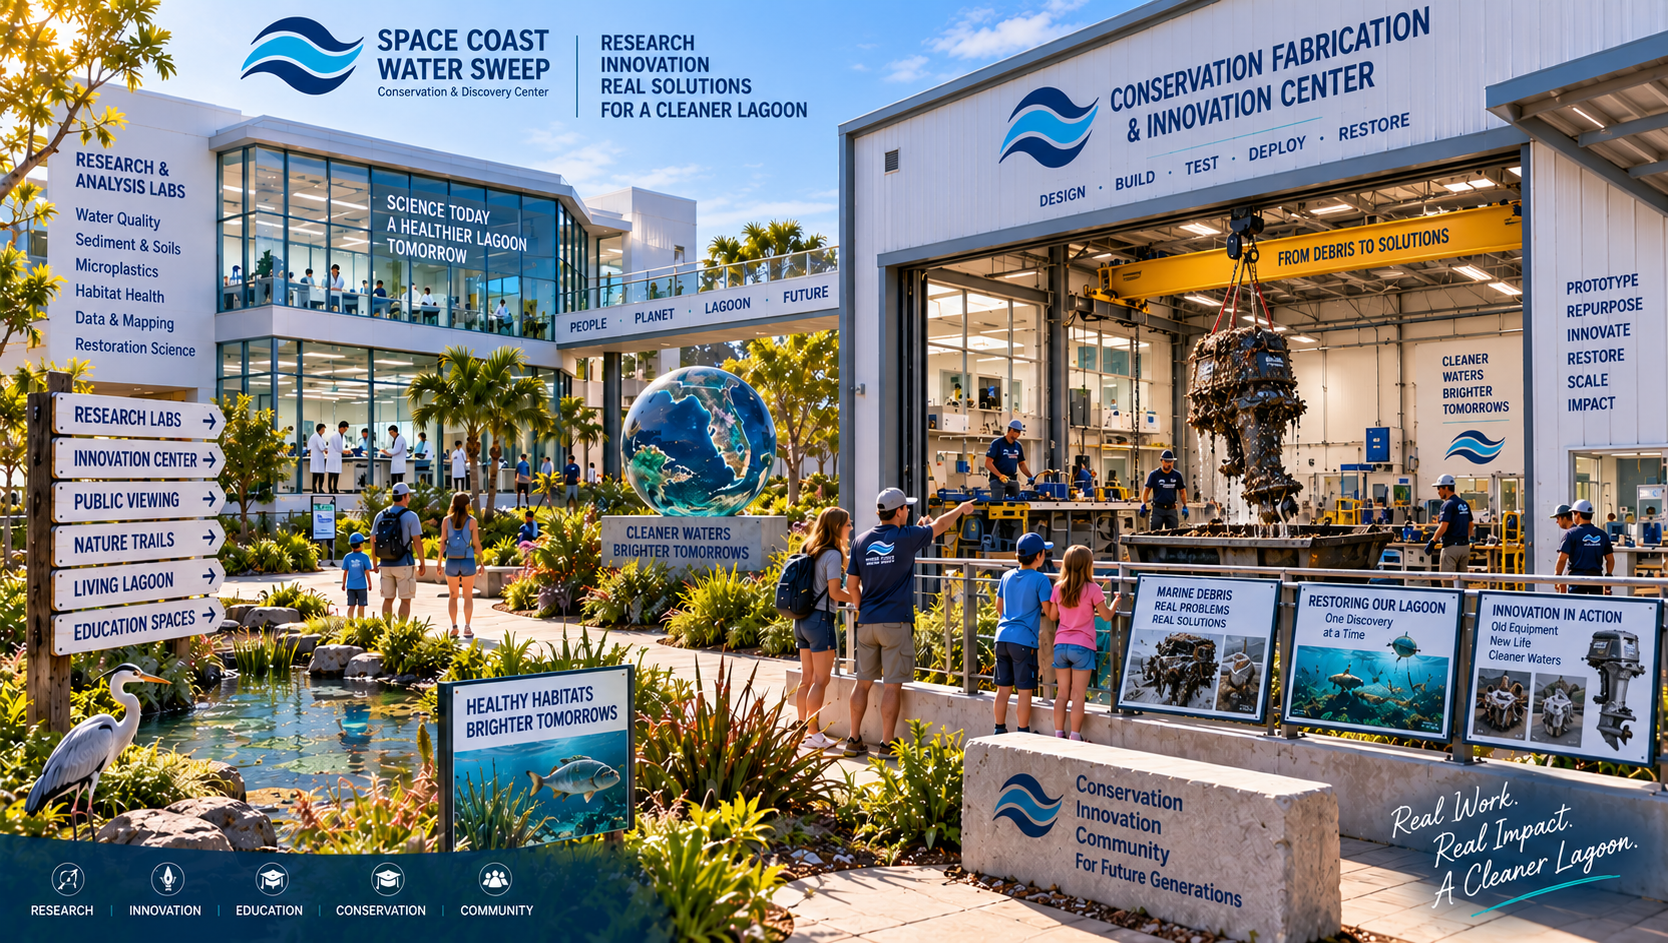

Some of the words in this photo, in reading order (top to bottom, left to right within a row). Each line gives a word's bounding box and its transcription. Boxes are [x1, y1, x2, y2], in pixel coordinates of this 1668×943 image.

[1110, 50, 1263, 112] CONSERVATION
[1272, 5, 1430, 73] FABRICATION
[1127, 117, 1141, 143] &
[1147, 84, 1272, 139] INNOVATION
[1280, 60, 1375, 107] CENTER
[76, 151, 154, 175] RESEARCH
[158, 161, 170, 177] &
[1039, 185, 1086, 208] DESIGN
[1115, 170, 1156, 191] BUILD
[1184, 155, 1219, 176] TEST
[1249, 135, 1307, 162] DEPLOY
[1339, 112, 1410, 142] RESTORE
[75, 172, 146, 195] ANALYSIS
[149, 180, 186, 199] LABS
[75, 207, 114, 224] Water
[117, 211, 161, 232] Quality
[386, 194, 445, 218] SCIENCE
[448, 204, 491, 225] TODAY
[75, 232, 136, 251] Sediment
[139, 239, 149, 252] &
[152, 239, 181, 256] Soils
[386, 216, 397, 233] A
[400, 218, 473, 244] HEALTHIER
[476, 230, 527, 252] LAGOON
[386, 237, 467, 264] TOMORROW
[1278, 247, 1310, 267] FROM
[1313, 241, 1355, 262] DEBRIS
[1358, 238, 1375, 255] TO
[1378, 227, 1450, 253] SOLUTIONS
[75, 257, 159, 278] Microplastics
[75, 283, 122, 301] Habitat
[125, 287, 165, 304] Health
[1566, 273, 1639, 296] PROTOTYPE
[570, 317, 608, 333] PEOPLE
[634, 307, 675, 325] PLANET
[705, 296, 751, 315] LAGOON
[783, 285, 829, 304] FUTURE
[1567, 296, 1643, 318] REPURPOSE
[75, 310, 106, 326] Data
[109, 312, 119, 327] &
[122, 313, 175, 333] Mapping
[1567, 322, 1631, 342] INNOVATE
[75, 337, 147, 354] Restoration
[150, 341, 196, 357] Science
[1567, 347, 1625, 366] RESTORE
[1442, 352, 1489, 367] CLEANER
[1442, 369, 1484, 383] WATERS
[1567, 372, 1609, 389] SCALE
[1442, 385, 1493, 399] BRIGHTER
[1442, 400, 1510, 415] TOMORROWS
[1568, 395, 1616, 412] IMPACT
[74, 405, 146, 426] RESEARCH
[150, 410, 182, 428] LABS
[74, 449, 151, 467] INNOVATION
[153, 451, 198, 468] CENTER
[74, 492, 124, 511] PUBLIC
[126, 491, 180, 509] VIEWING
[74, 534, 128, 554] NATURE
[131, 531, 175, 550] TRAILS
[626, 525, 680, 540] CLEANER
[682, 526, 731, 541] WATERS
[613, 543, 670, 558] BRIGHTER
[672, 544, 750, 560] TOMORROWS
[74, 576, 119, 598] LIVING
[122, 571, 174, 592] LAGOON
[1156, 585, 1195, 599] MARINE
[1196, 588, 1233, 601] DEBRIS
[1154, 600, 1178, 612] REAL
[1179, 602, 1230, 616] PROBLEMS
[1308, 594, 1370, 610] RESTORING
[1372, 597, 1396, 612] OUR
[1398, 599, 1447, 615] LAGOON
[1492, 604, 1561, 620] INNOVATION
[1563, 607, 1576, 621] IN
[1578, 608, 1623, 624] ACTION
[74, 615, 148, 641] EDUCATION
[151, 609, 196, 631] SPACES
[1151, 614, 1175, 625] REAL
[1176, 616, 1227, 629] SOLUTIONS
[1325, 612, 1345, 624] One
[1346, 613, 1394, 630] Discovery
[1491, 621, 1508, 632] Old
[1508, 622, 1559, 636] Equipment
[1322, 627, 1333, 638] at
[1333, 629, 1341, 638] a
[1343, 628, 1366, 640] Time
[1489, 635, 1512, 647] New
[1513, 637, 1532, 649] Life
[1488, 649, 1526, 663] Cleaner
[1527, 652, 1562, 666] Waters
[466, 692, 529, 716] HEALTHY
[532, 685, 594, 708] HABITATS
[466, 714, 533, 739] BRIGHTER
[536, 704, 618, 730] TOMORROWS
[1076, 774, 1183, 812] Conservation
[1076, 799, 1162, 835] Innovation
[1075, 825, 1171, 868] Community
[1075, 852, 1098, 873] For
[1101, 858, 1147, 885] Future
[1150, 870, 1243, 908] Generations
